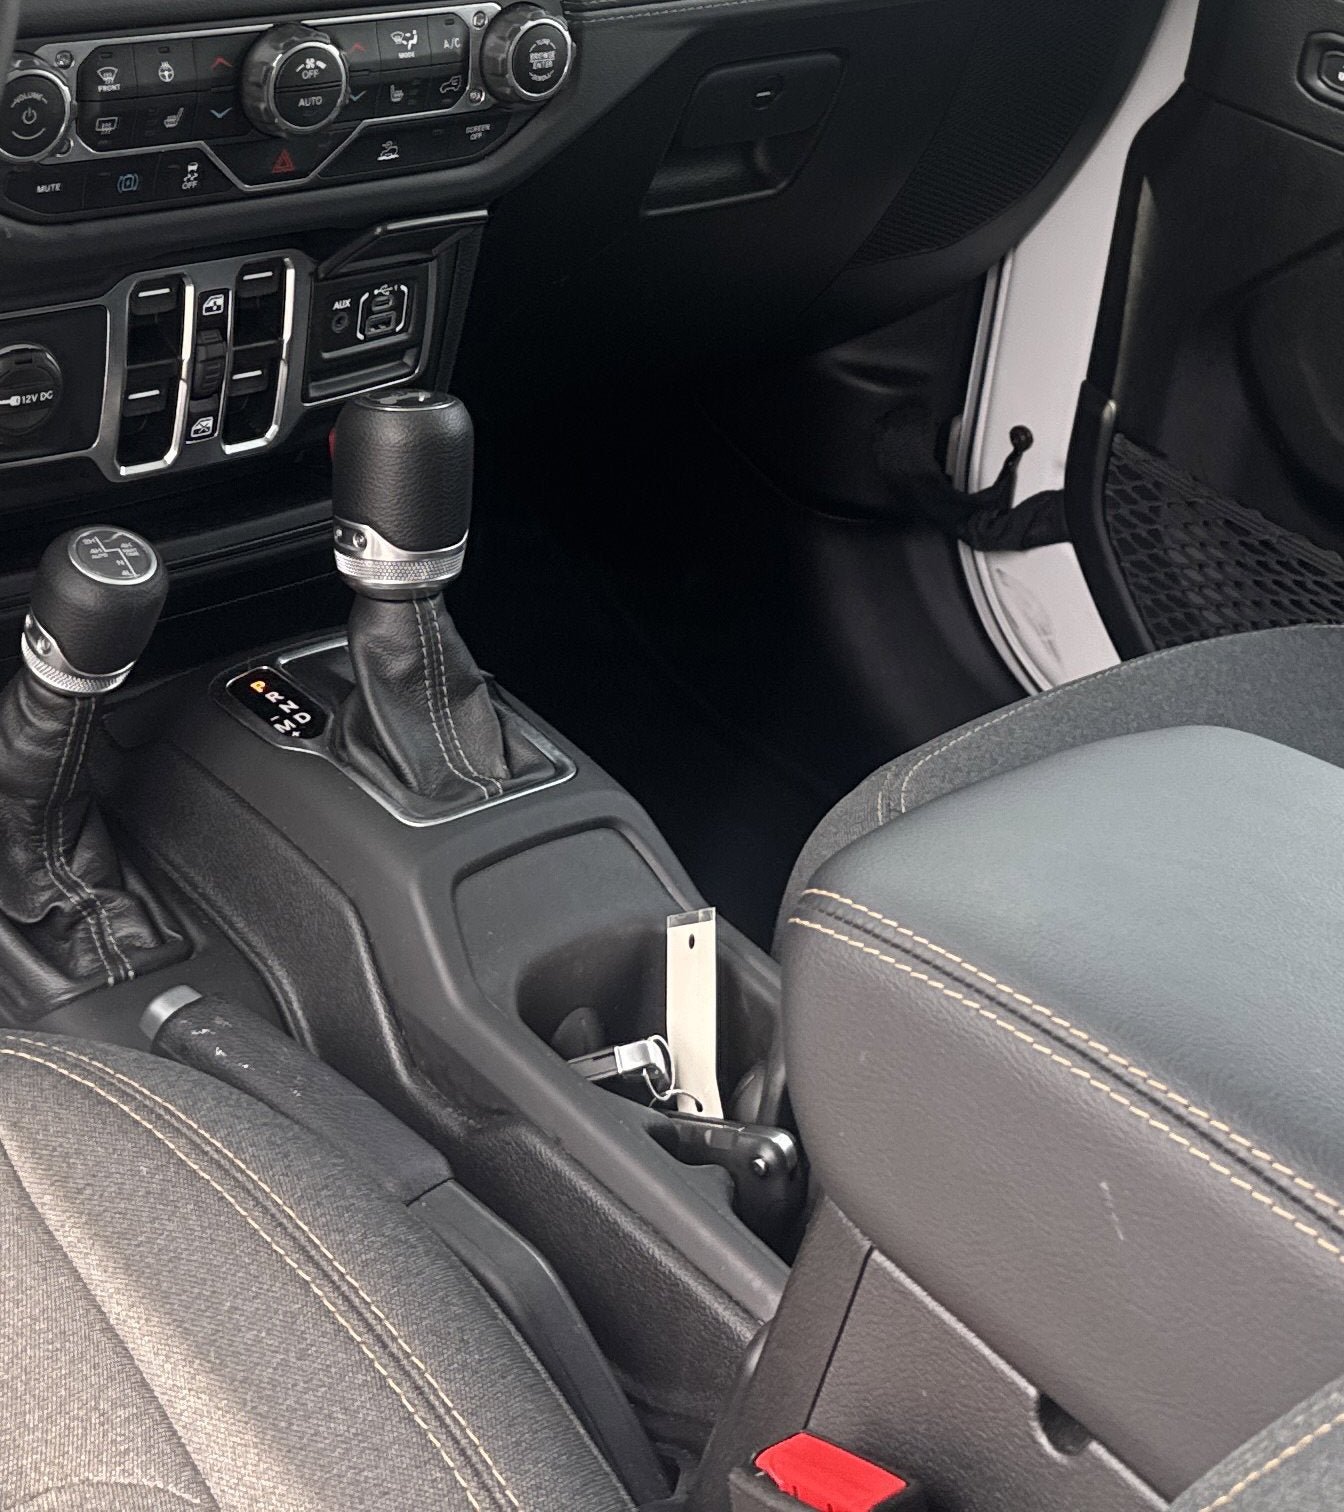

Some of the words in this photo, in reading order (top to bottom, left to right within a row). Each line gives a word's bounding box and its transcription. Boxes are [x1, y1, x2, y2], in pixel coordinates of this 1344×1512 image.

[443, 37, 461, 50] A/C
[302, 69, 319, 80] OFF
[97, 83, 121, 92] FRONT
[298, 96, 323, 107] AUTO
[36, 183, 61, 193] MUTE
[182, 180, 197, 190] OFF
[333, 298, 351, 310] AUX
[21, 393, 38, 404] 12V
[39, 390, 53, 401] DC
[250, 680, 266, 693] P
[264, 691, 285, 703] R
[278, 700, 300, 713] N
[293, 712, 311, 724] D
[273, 719, 296, 733] M
